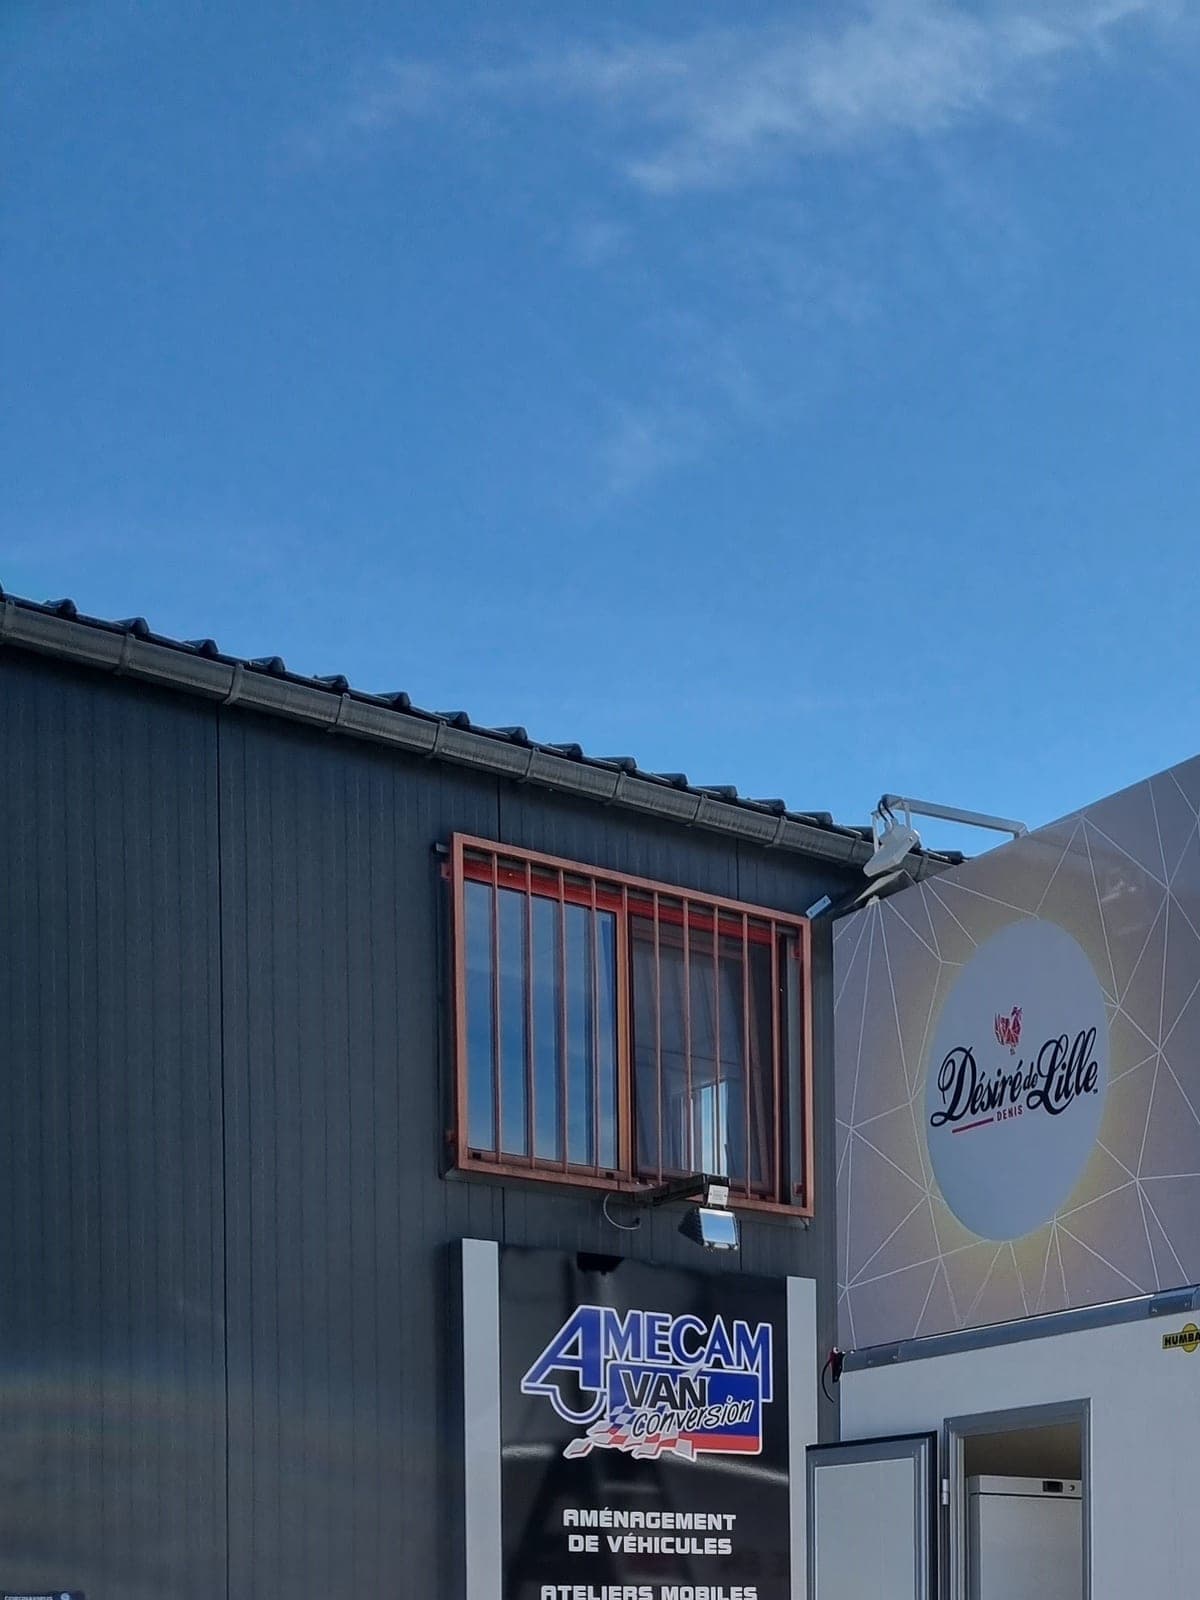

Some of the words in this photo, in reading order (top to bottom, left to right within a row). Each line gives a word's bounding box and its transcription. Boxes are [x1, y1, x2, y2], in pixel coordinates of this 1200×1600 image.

[930, 1046, 1023, 1128] Désiré
[1023, 1066, 1039, 1092] de
[1026, 1026, 1099, 1116] Lille
[996, 1104, 1023, 1122] DENIS
[521, 1304, 774, 1425] AMECAM
[619, 1370, 710, 1411] VAN
[631, 1396, 755, 1438] conversion
[563, 1506, 737, 1531] AMÉNAGEMENT
[568, 1534, 599, 1552] DE
[606, 1533, 733, 1555] VÉHICULES
